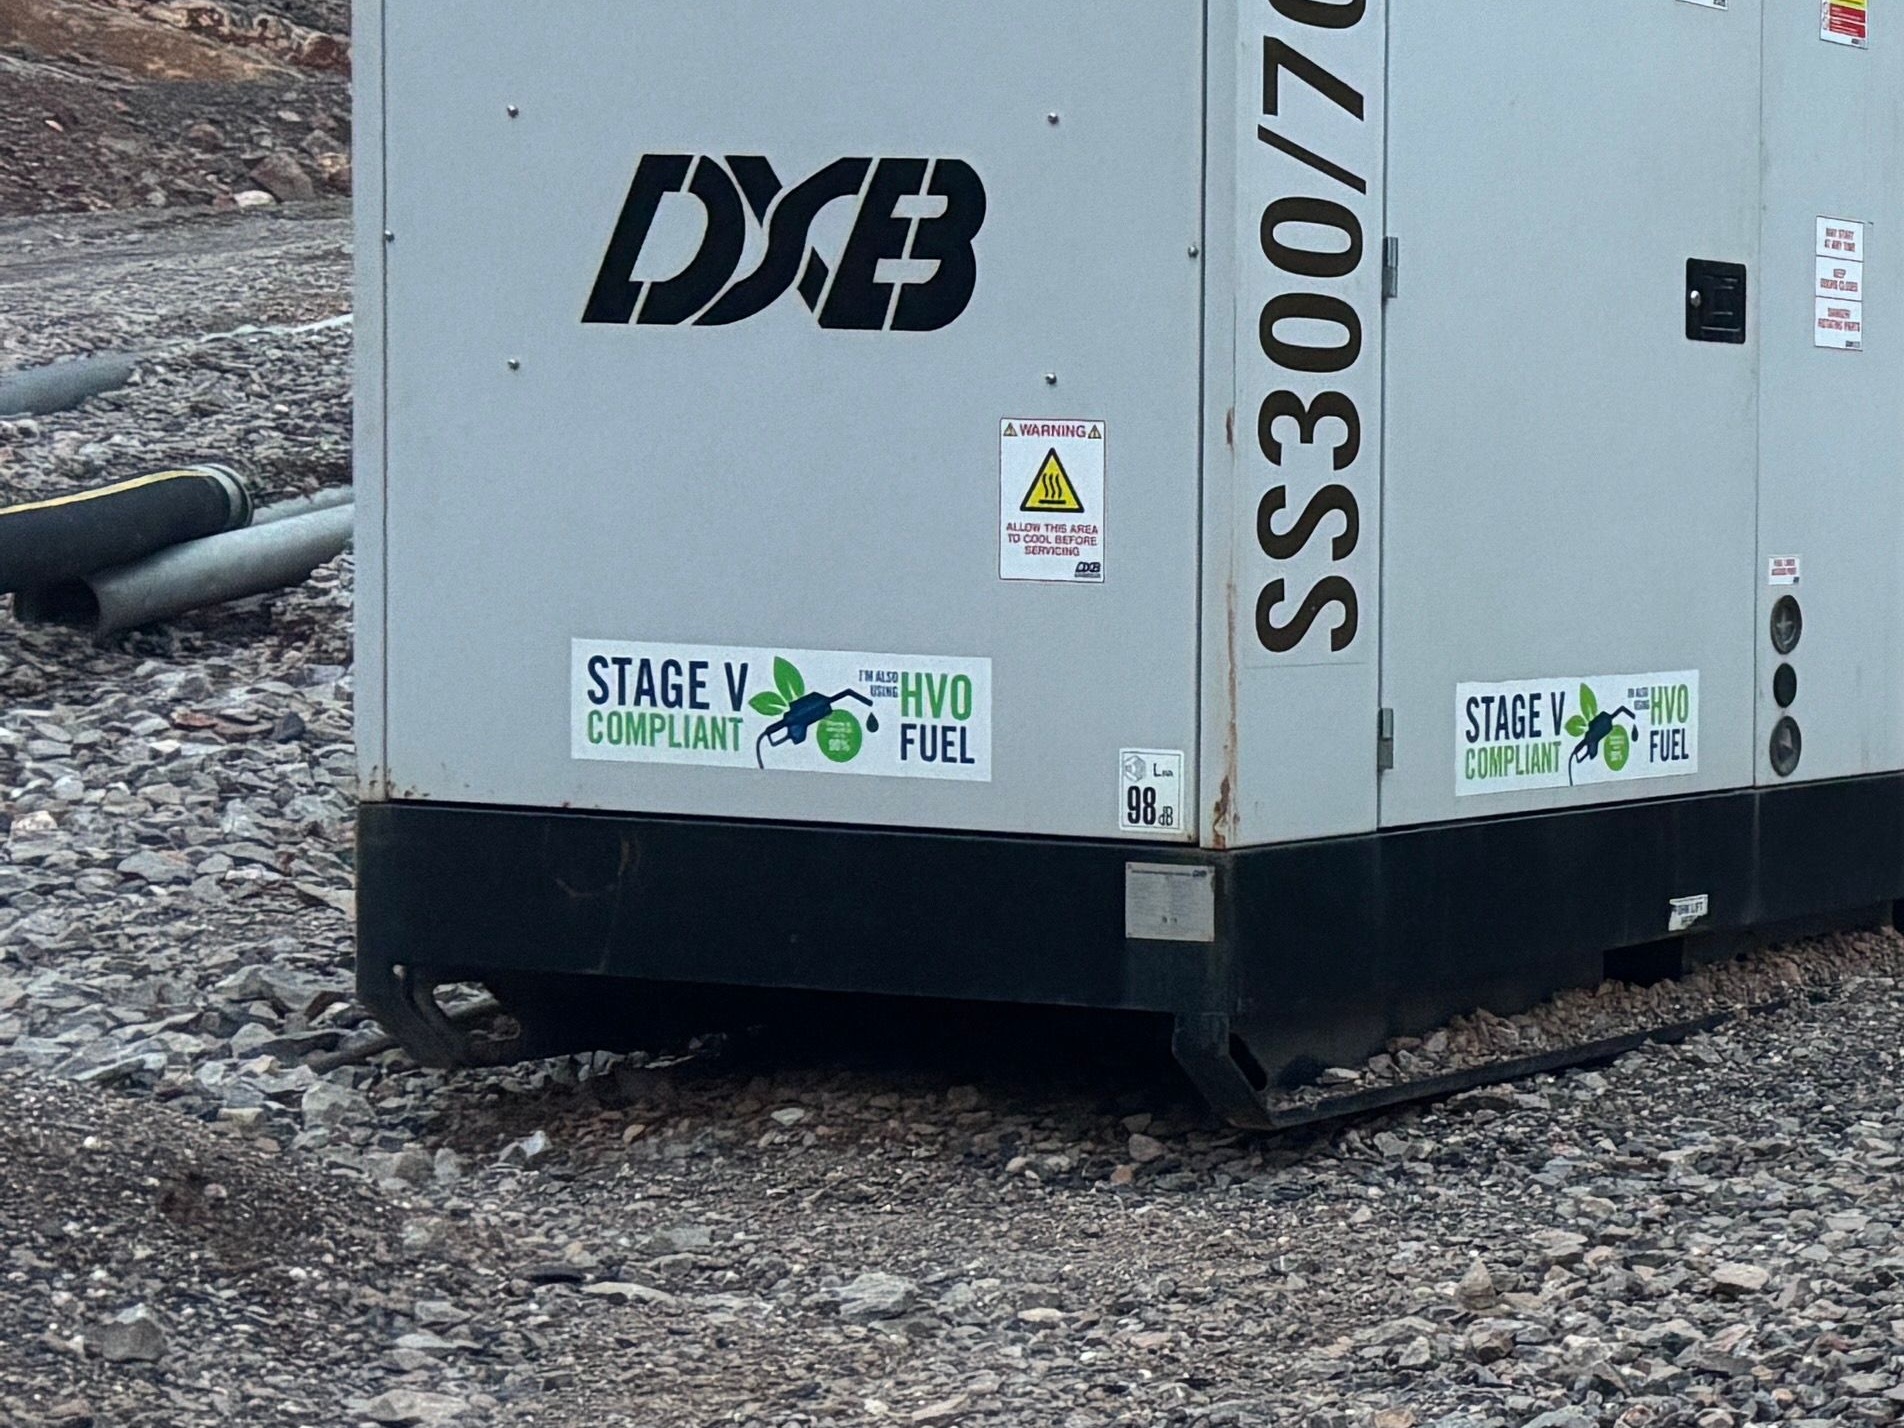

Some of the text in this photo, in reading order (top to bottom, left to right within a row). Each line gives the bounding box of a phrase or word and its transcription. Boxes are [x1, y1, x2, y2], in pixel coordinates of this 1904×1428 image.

[581, 154, 986, 331] DXB
[1020, 424, 1087, 439] WARNING
[1006, 522, 1098, 535] ALLOW THIS AREA
[1008, 534, 1097, 546] TO COOL BEFORE
[1024, 545, 1080, 557] SERVICING
[587, 654, 749, 712] STAGE V
[870, 685, 899, 698] USING
[876, 671, 899, 684] ALSO
[901, 672, 973, 721] HVO
[1465, 691, 1565, 743] STAGE V
[1650, 684, 1689, 725] HVO
[587, 709, 744, 752] COMPLIANT
[901, 723, 976, 764] FUEL
[1650, 728, 1689, 763] FUEL
[1465, 741, 1562, 780] COMPLIANT
[1127, 785, 1174, 826] 98 dB
